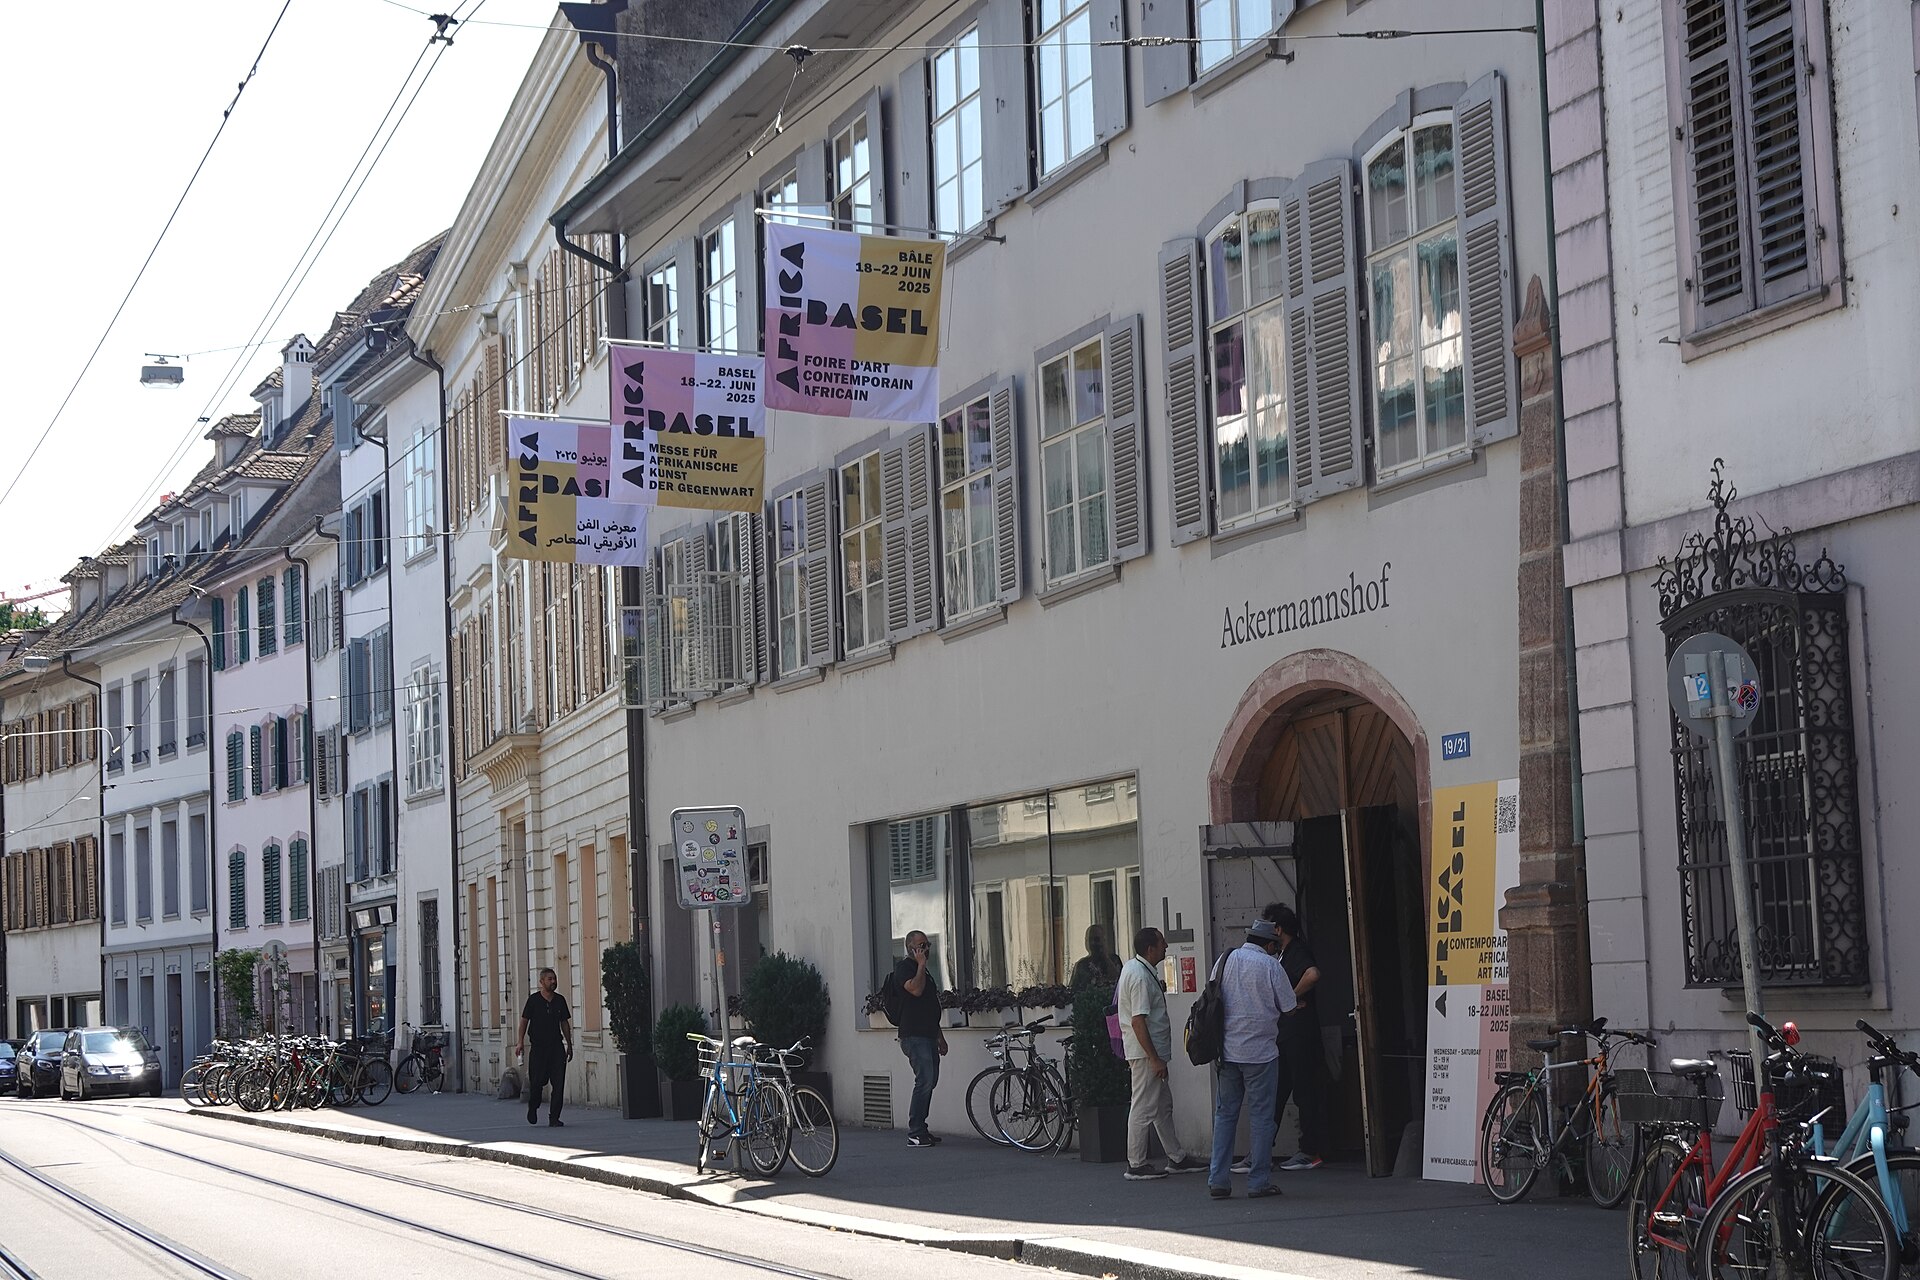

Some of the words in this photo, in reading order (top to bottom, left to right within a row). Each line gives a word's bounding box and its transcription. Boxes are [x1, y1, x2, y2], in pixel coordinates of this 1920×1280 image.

[899, 250, 933, 265] BÂLE
[902, 266, 931, 280] JUIN
[898, 281, 931, 293] 2025
[776, 242, 805, 393] AFRICA
[807, 299, 928, 335] BASEL
[804, 355, 846, 369] FOIRE
[718, 367, 756, 379] BASEL
[803, 370, 913, 390] CONTEMPORAIN
[729, 380, 756, 391] JUNI
[804, 385, 869, 401] AFRICAIN
[726, 392, 756, 403] 2025
[622, 361, 645, 489] AFRICA
[648, 409, 755, 438] BASEL
[555, 450, 577, 461] ٢٠٢٥
[649, 443, 689, 457] MESSE
[693, 446, 718, 459] FÜR
[580, 452, 608, 467] يونيو
[650, 456, 738, 473] AFRIKANISCHE
[650, 467, 687, 481] KUNST
[518, 432, 539, 546] AFRICA
[649, 480, 674, 491] DER
[677, 484, 755, 497] GEGENWART
[577, 518, 600, 532] الفن
[602, 521, 637, 535] معرض
[546, 533, 591, 548] المعاصر
[593, 536, 637, 553] الأفريقي
[1221, 561, 1392, 649] Ackermannshof
[1444, 737, 1467, 755] 19/21
[1450, 801, 1466, 933] BASEL
[1434, 865, 1451, 1018] AFRICA
[1450, 936, 1508, 950] CONTEMPORAR
[1478, 951, 1508, 965] AFRICA
[1477, 966, 1492, 979] ART
[1486, 989, 1509, 1001] BASEL
[1490, 1004, 1509, 1017] JUNE
[1490, 1020, 1509, 1032] 2025
[1495, 1049, 1508, 1061] ART
